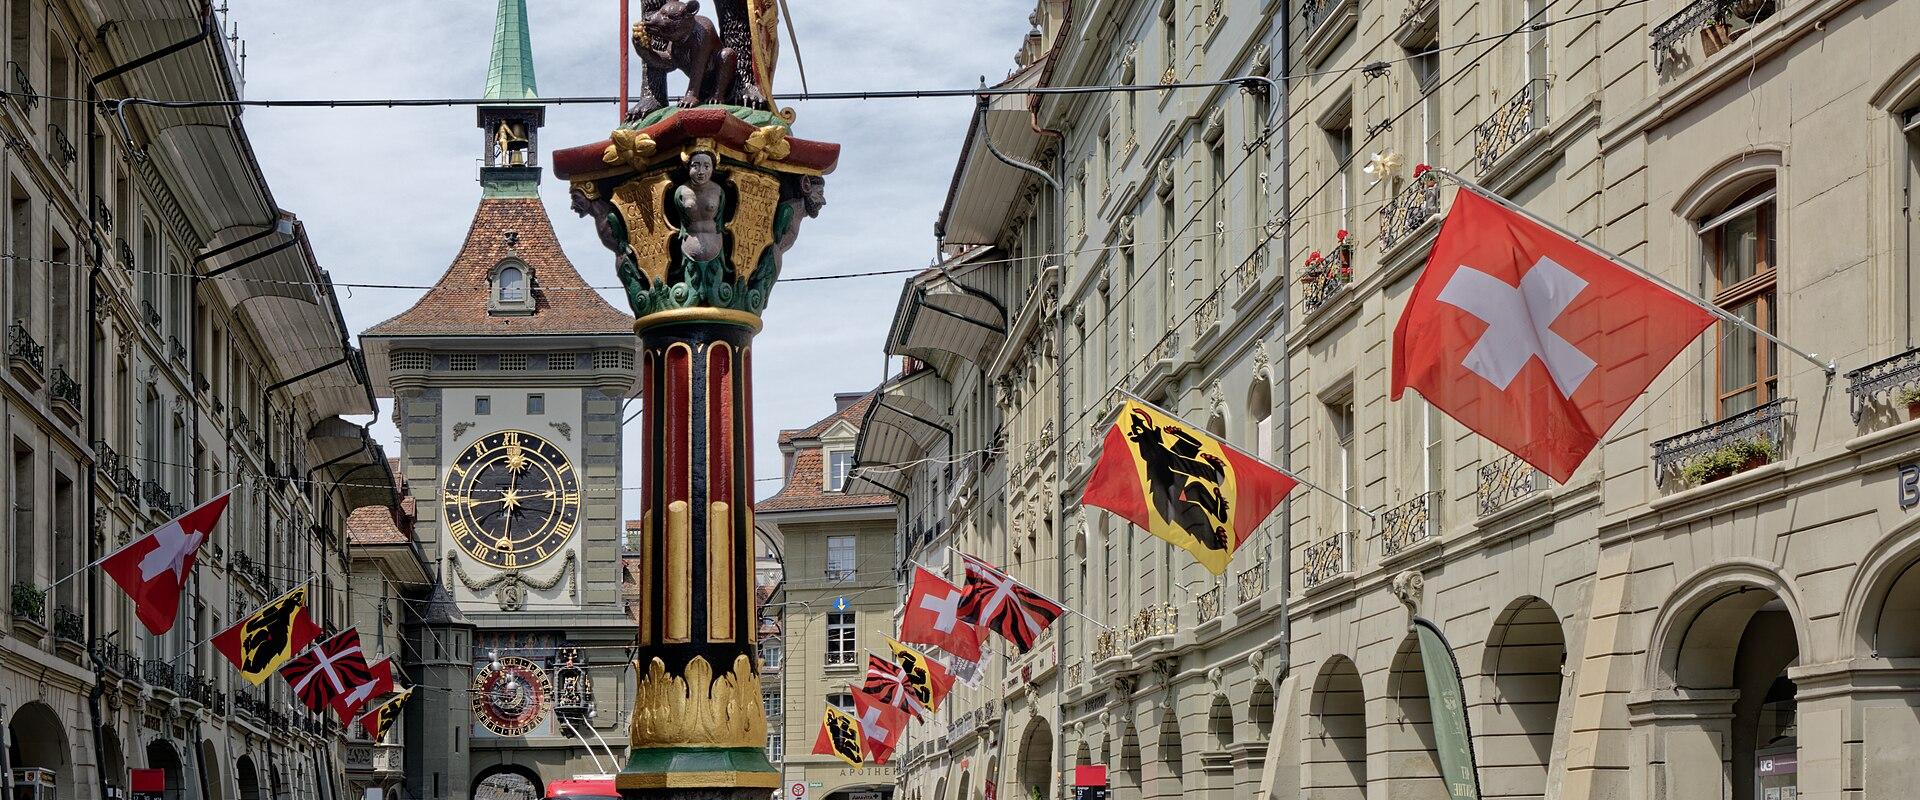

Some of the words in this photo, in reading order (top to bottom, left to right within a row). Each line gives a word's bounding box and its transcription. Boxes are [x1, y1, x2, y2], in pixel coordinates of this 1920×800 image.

[502, 432, 518, 446] XII
[474, 440, 488, 457] XI
[454, 464, 466, 477] X
[557, 462, 570, 475] II
[445, 492, 459, 505] IX
[564, 493, 579, 505] III
